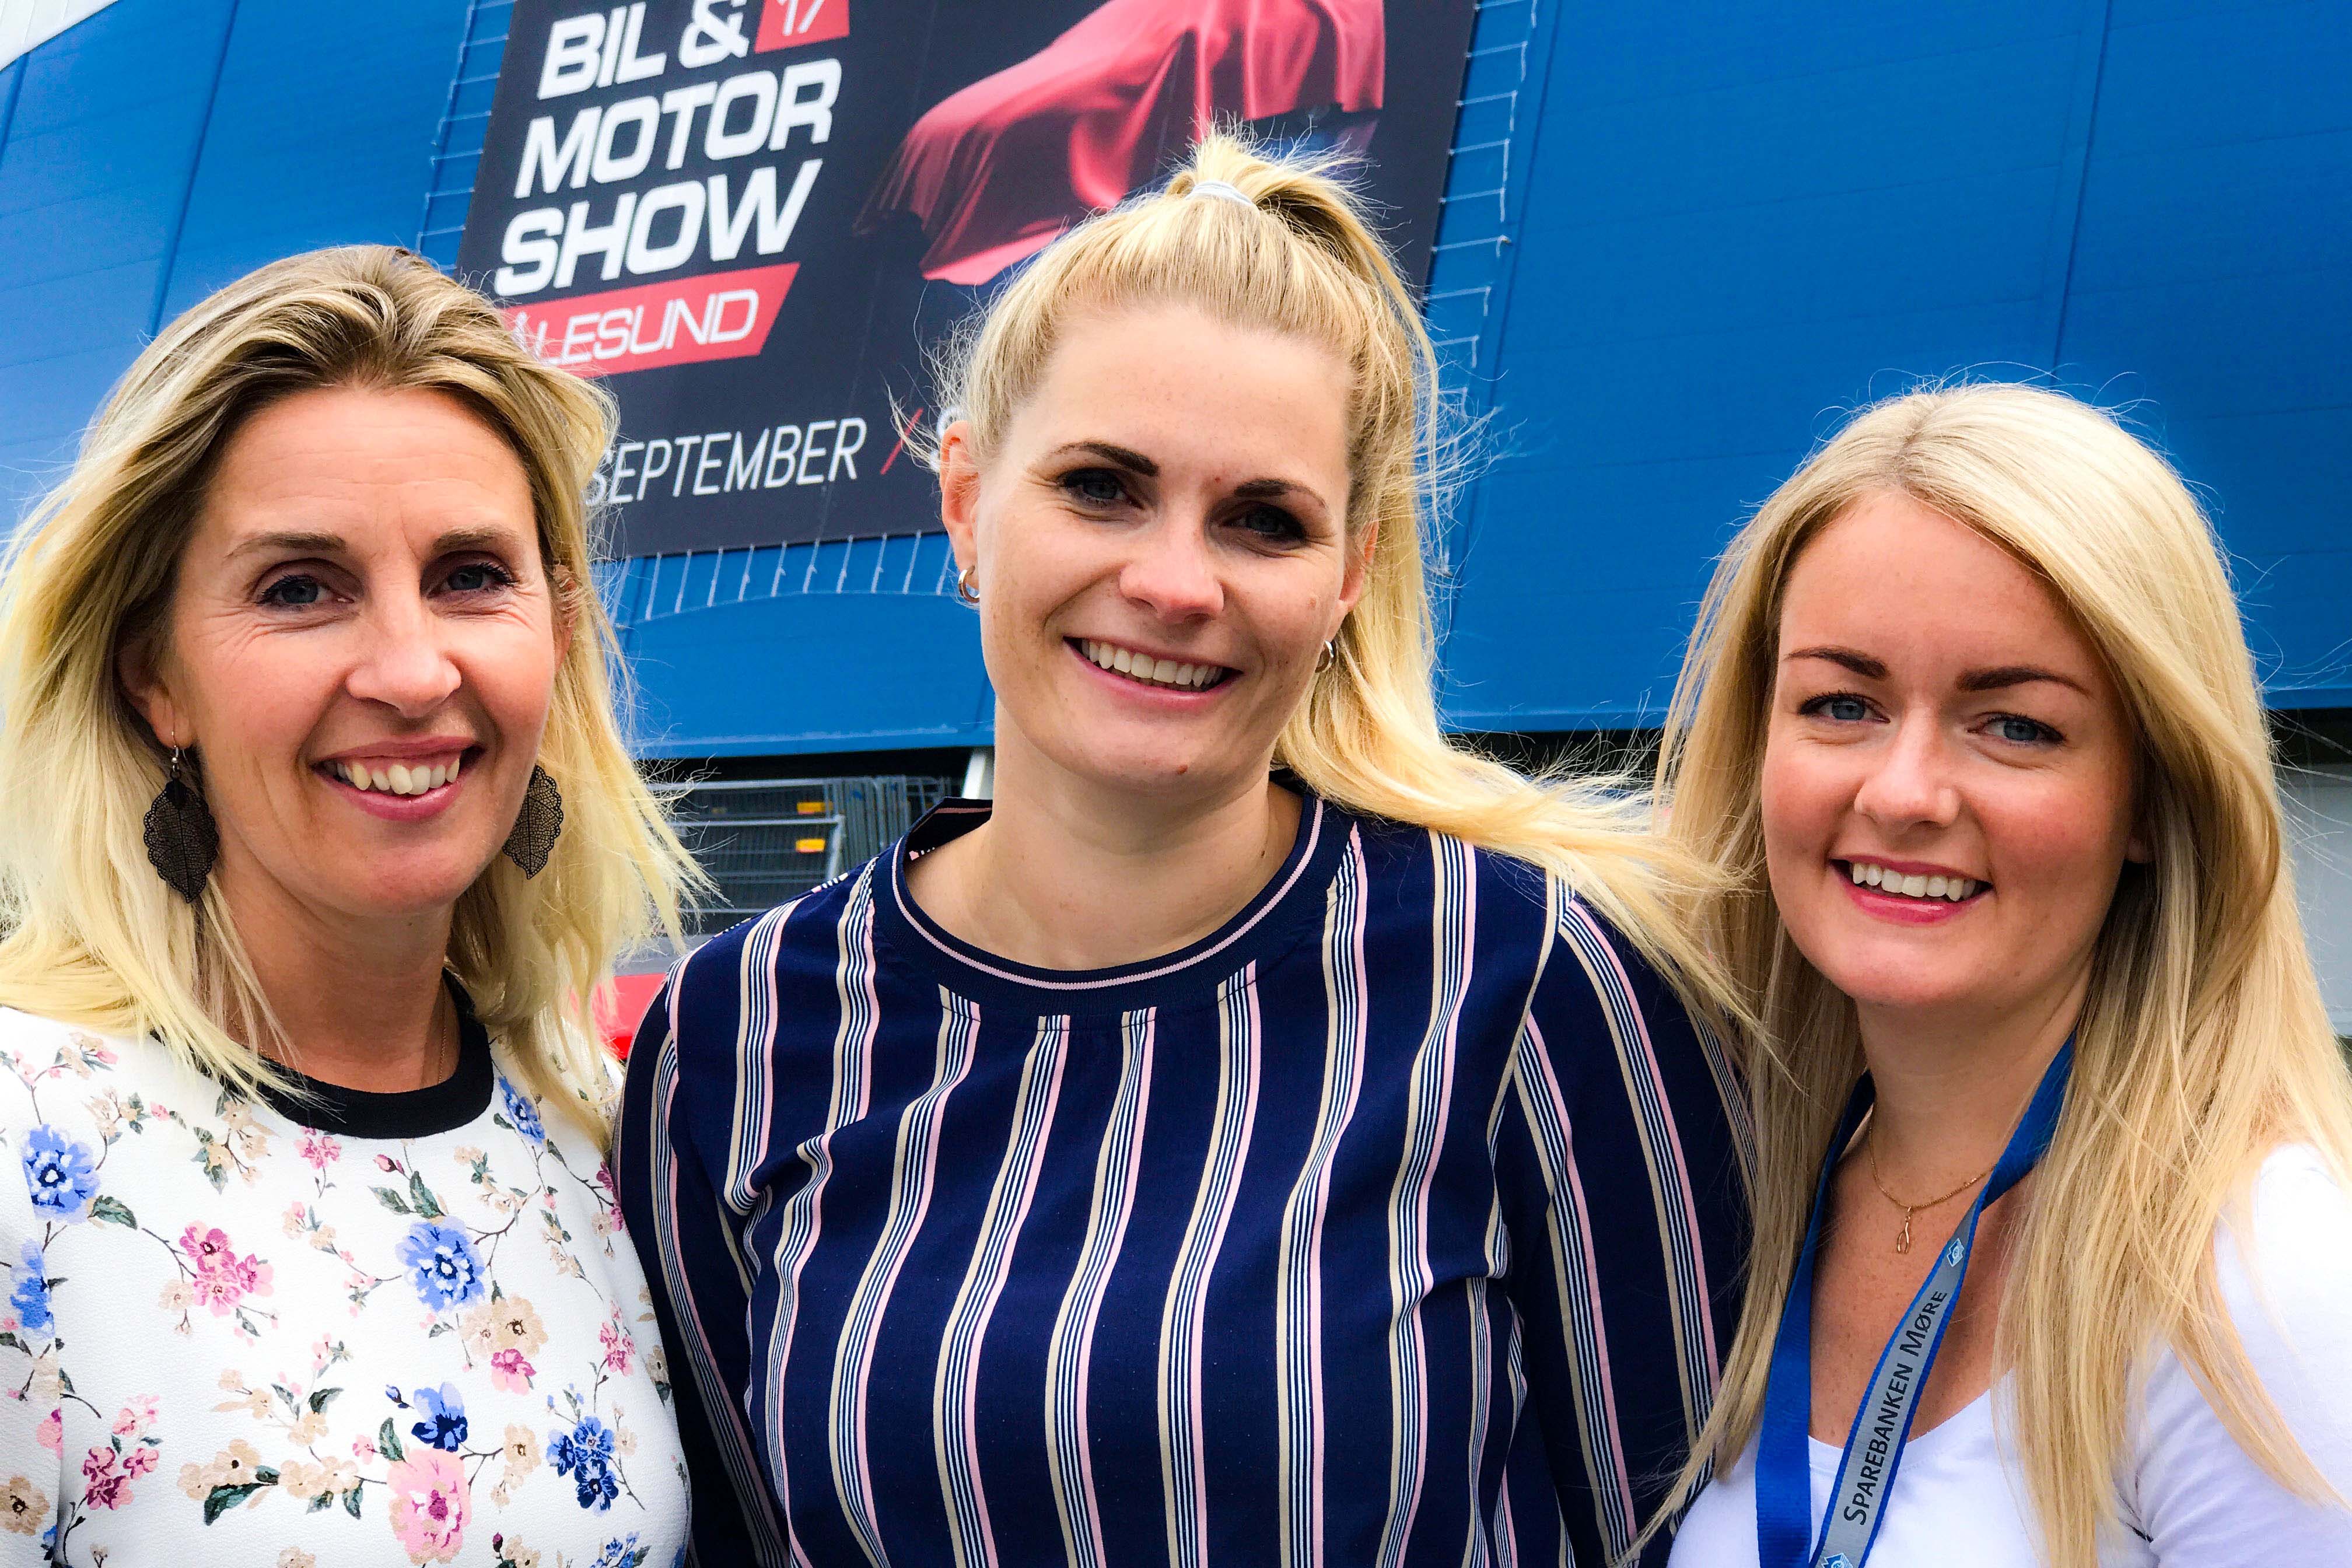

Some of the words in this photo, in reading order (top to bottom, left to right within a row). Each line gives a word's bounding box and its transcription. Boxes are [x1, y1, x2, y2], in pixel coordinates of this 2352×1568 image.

[538, 2, 667, 100] BIL
[678, 0, 749, 68] &
[514, 58, 841, 198] MOTOR
[494, 159, 822, 296] SHOW
[585, 417, 867, 506] SEPTEMBER
[1844, 1363, 1913, 1525] SPAREBANKEN
[1900, 1291, 1947, 1357] MØRE
